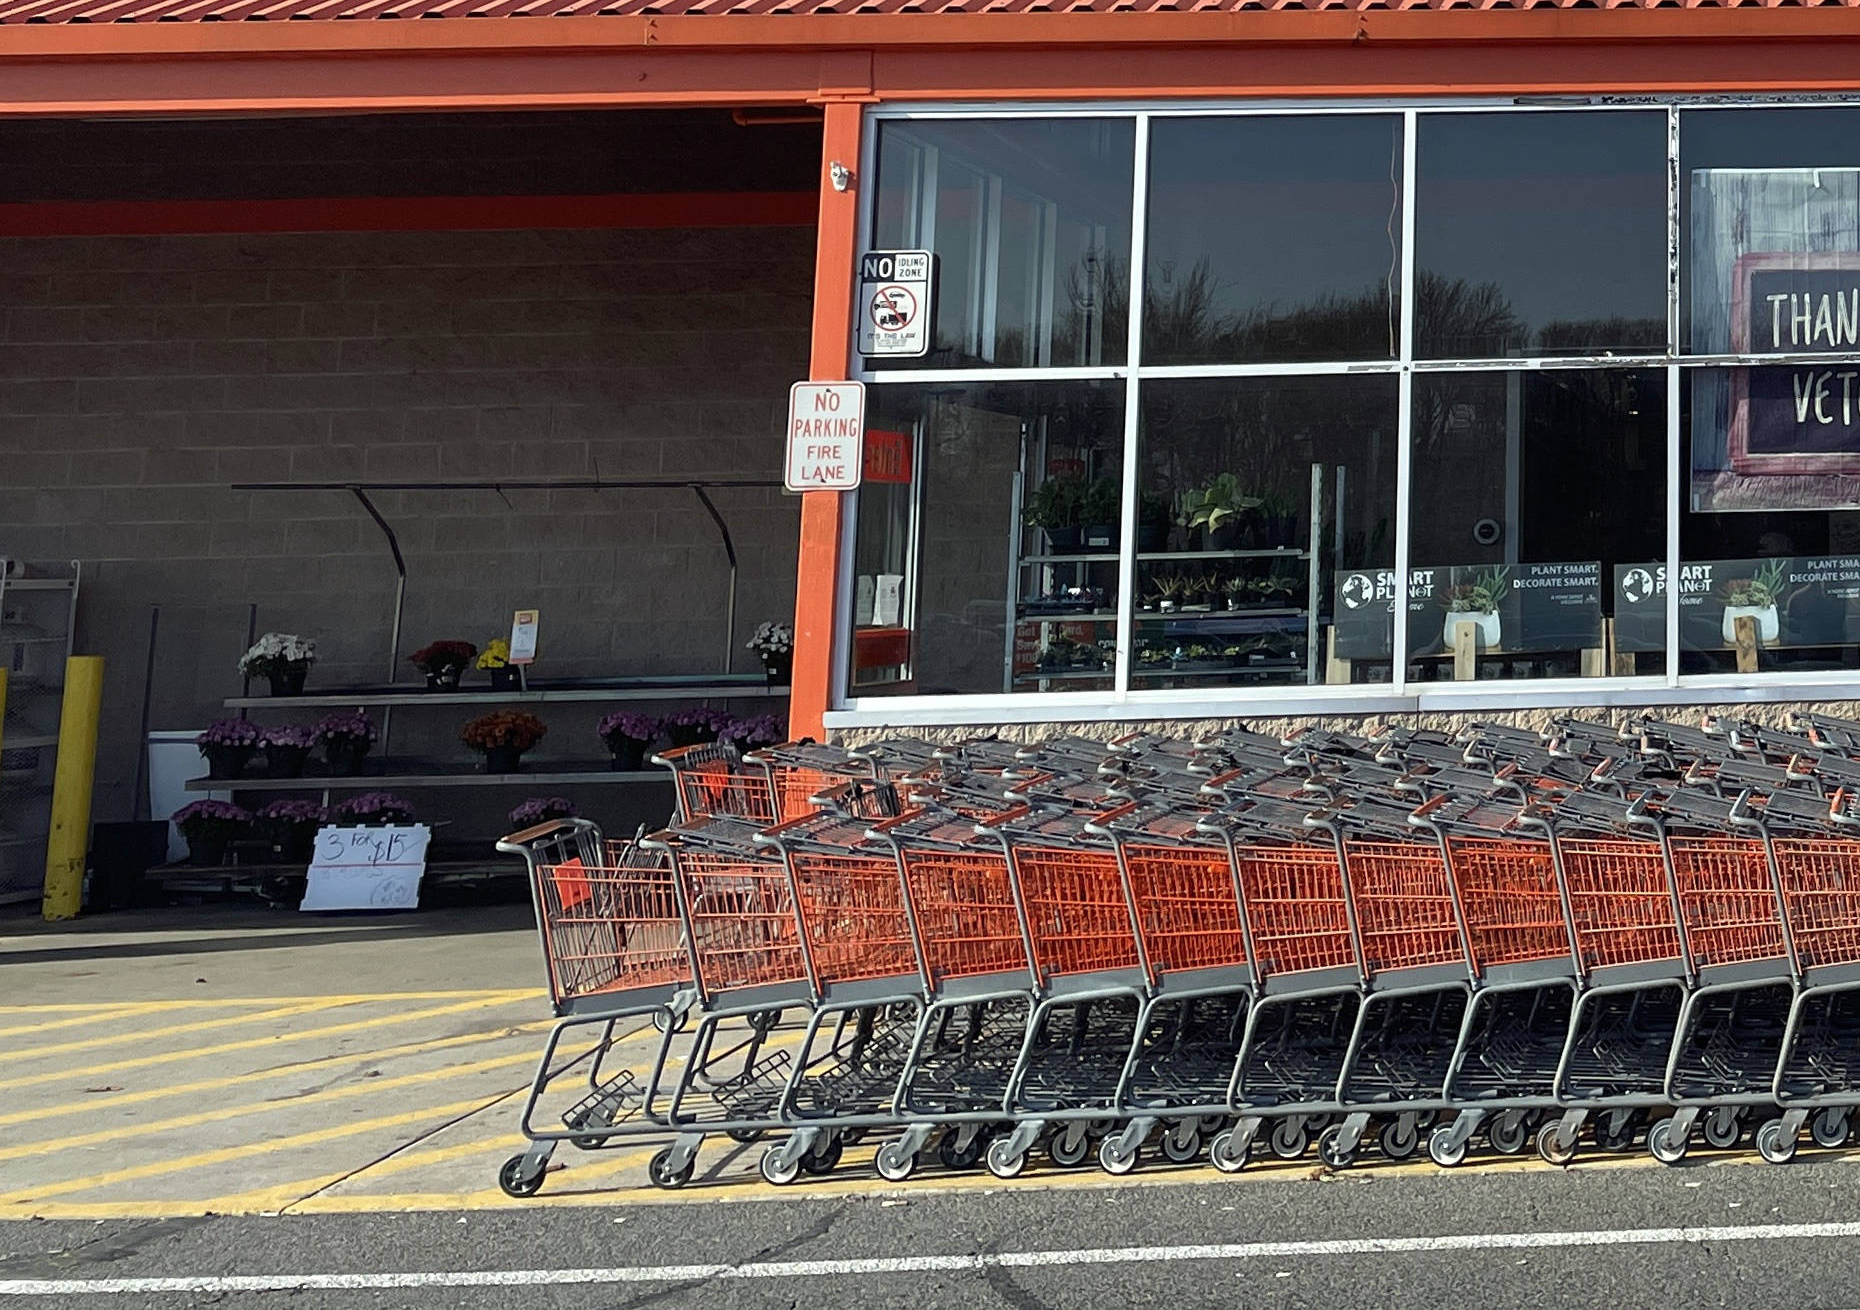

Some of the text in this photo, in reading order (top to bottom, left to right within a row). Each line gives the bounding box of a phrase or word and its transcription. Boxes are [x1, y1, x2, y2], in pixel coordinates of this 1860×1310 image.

[863, 257, 893, 278] NO
[898, 257, 925, 267] IDLING
[899, 268, 922, 277] ZONE
[814, 392, 841, 412] NO
[794, 417, 858, 438] PARKING
[807, 445, 842, 459] FIRE
[801, 465, 846, 480] LANE
[1531, 564, 1599, 575] PLANT SMART.
[1807, 560, 1838, 570] PLANT
[1656, 565, 1713, 581] SART
[1789, 572, 1840, 583] DECORATE
[1513, 577, 1599, 589] DECORATE SMART.
[321, 833, 345, 861] 3
[367, 833, 409, 866] $15
